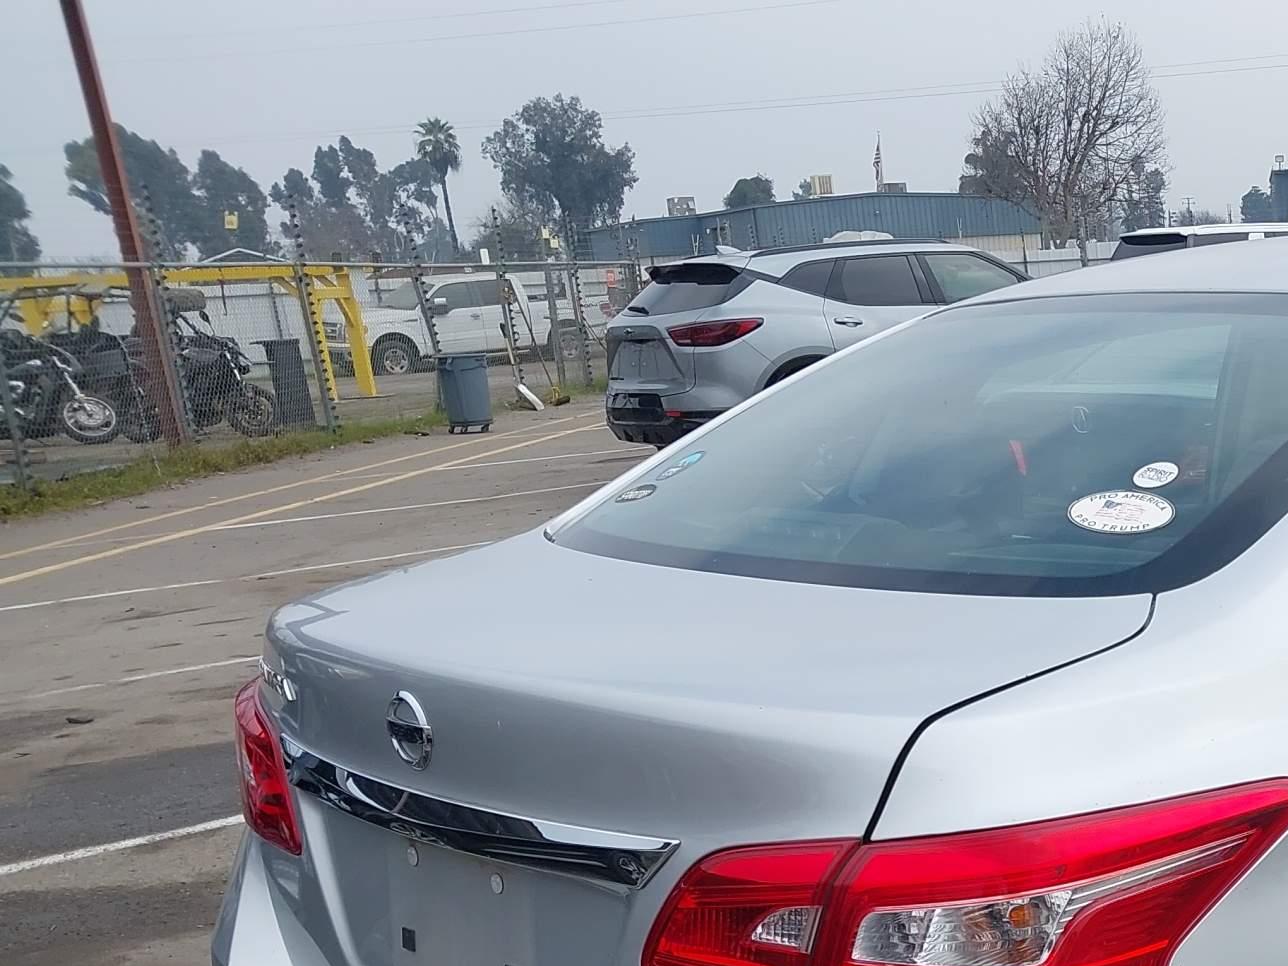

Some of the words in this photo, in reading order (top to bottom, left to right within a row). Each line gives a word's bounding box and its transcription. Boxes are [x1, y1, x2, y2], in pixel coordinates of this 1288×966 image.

[1090, 493, 1118, 502] PRO
[1122, 494, 1167, 511] AMERICA
[1074, 513, 1096, 526] PRO
[1102, 523, 1150, 531] TRUMP
